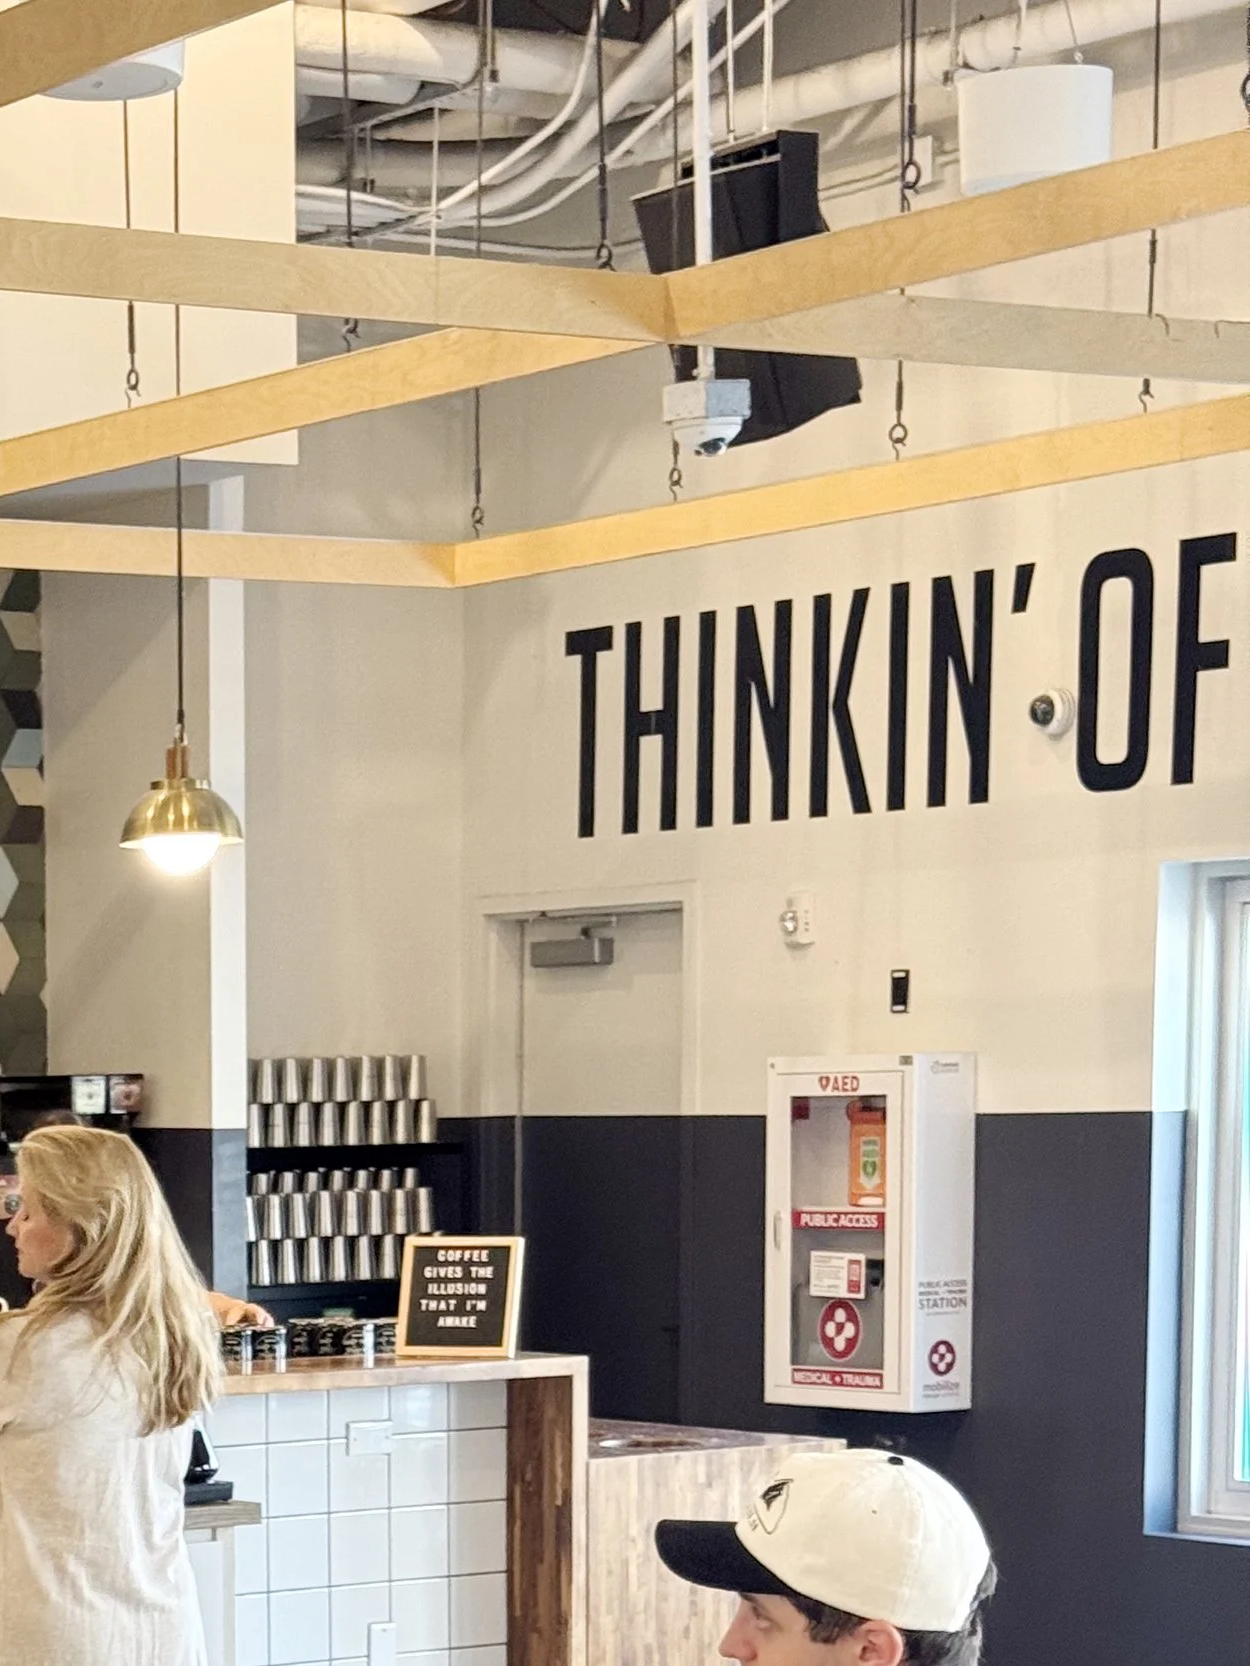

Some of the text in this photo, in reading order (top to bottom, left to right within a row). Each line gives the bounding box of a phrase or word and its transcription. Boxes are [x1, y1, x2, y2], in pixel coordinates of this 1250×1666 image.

[1076, 531, 1237, 793] OF
[831, 1075, 860, 1092] AED
[800, 1213, 878, 1228] PUBLIC ACCESS
[437, 1250, 489, 1262] COFFEE
[423, 1266, 494, 1278] GIVES THE
[427, 1283, 487, 1295] ILLUSION
[419, 1299, 457, 1311] THAT
[918, 1297, 967, 1310] STATION
[437, 1316, 477, 1328] AWAKE
